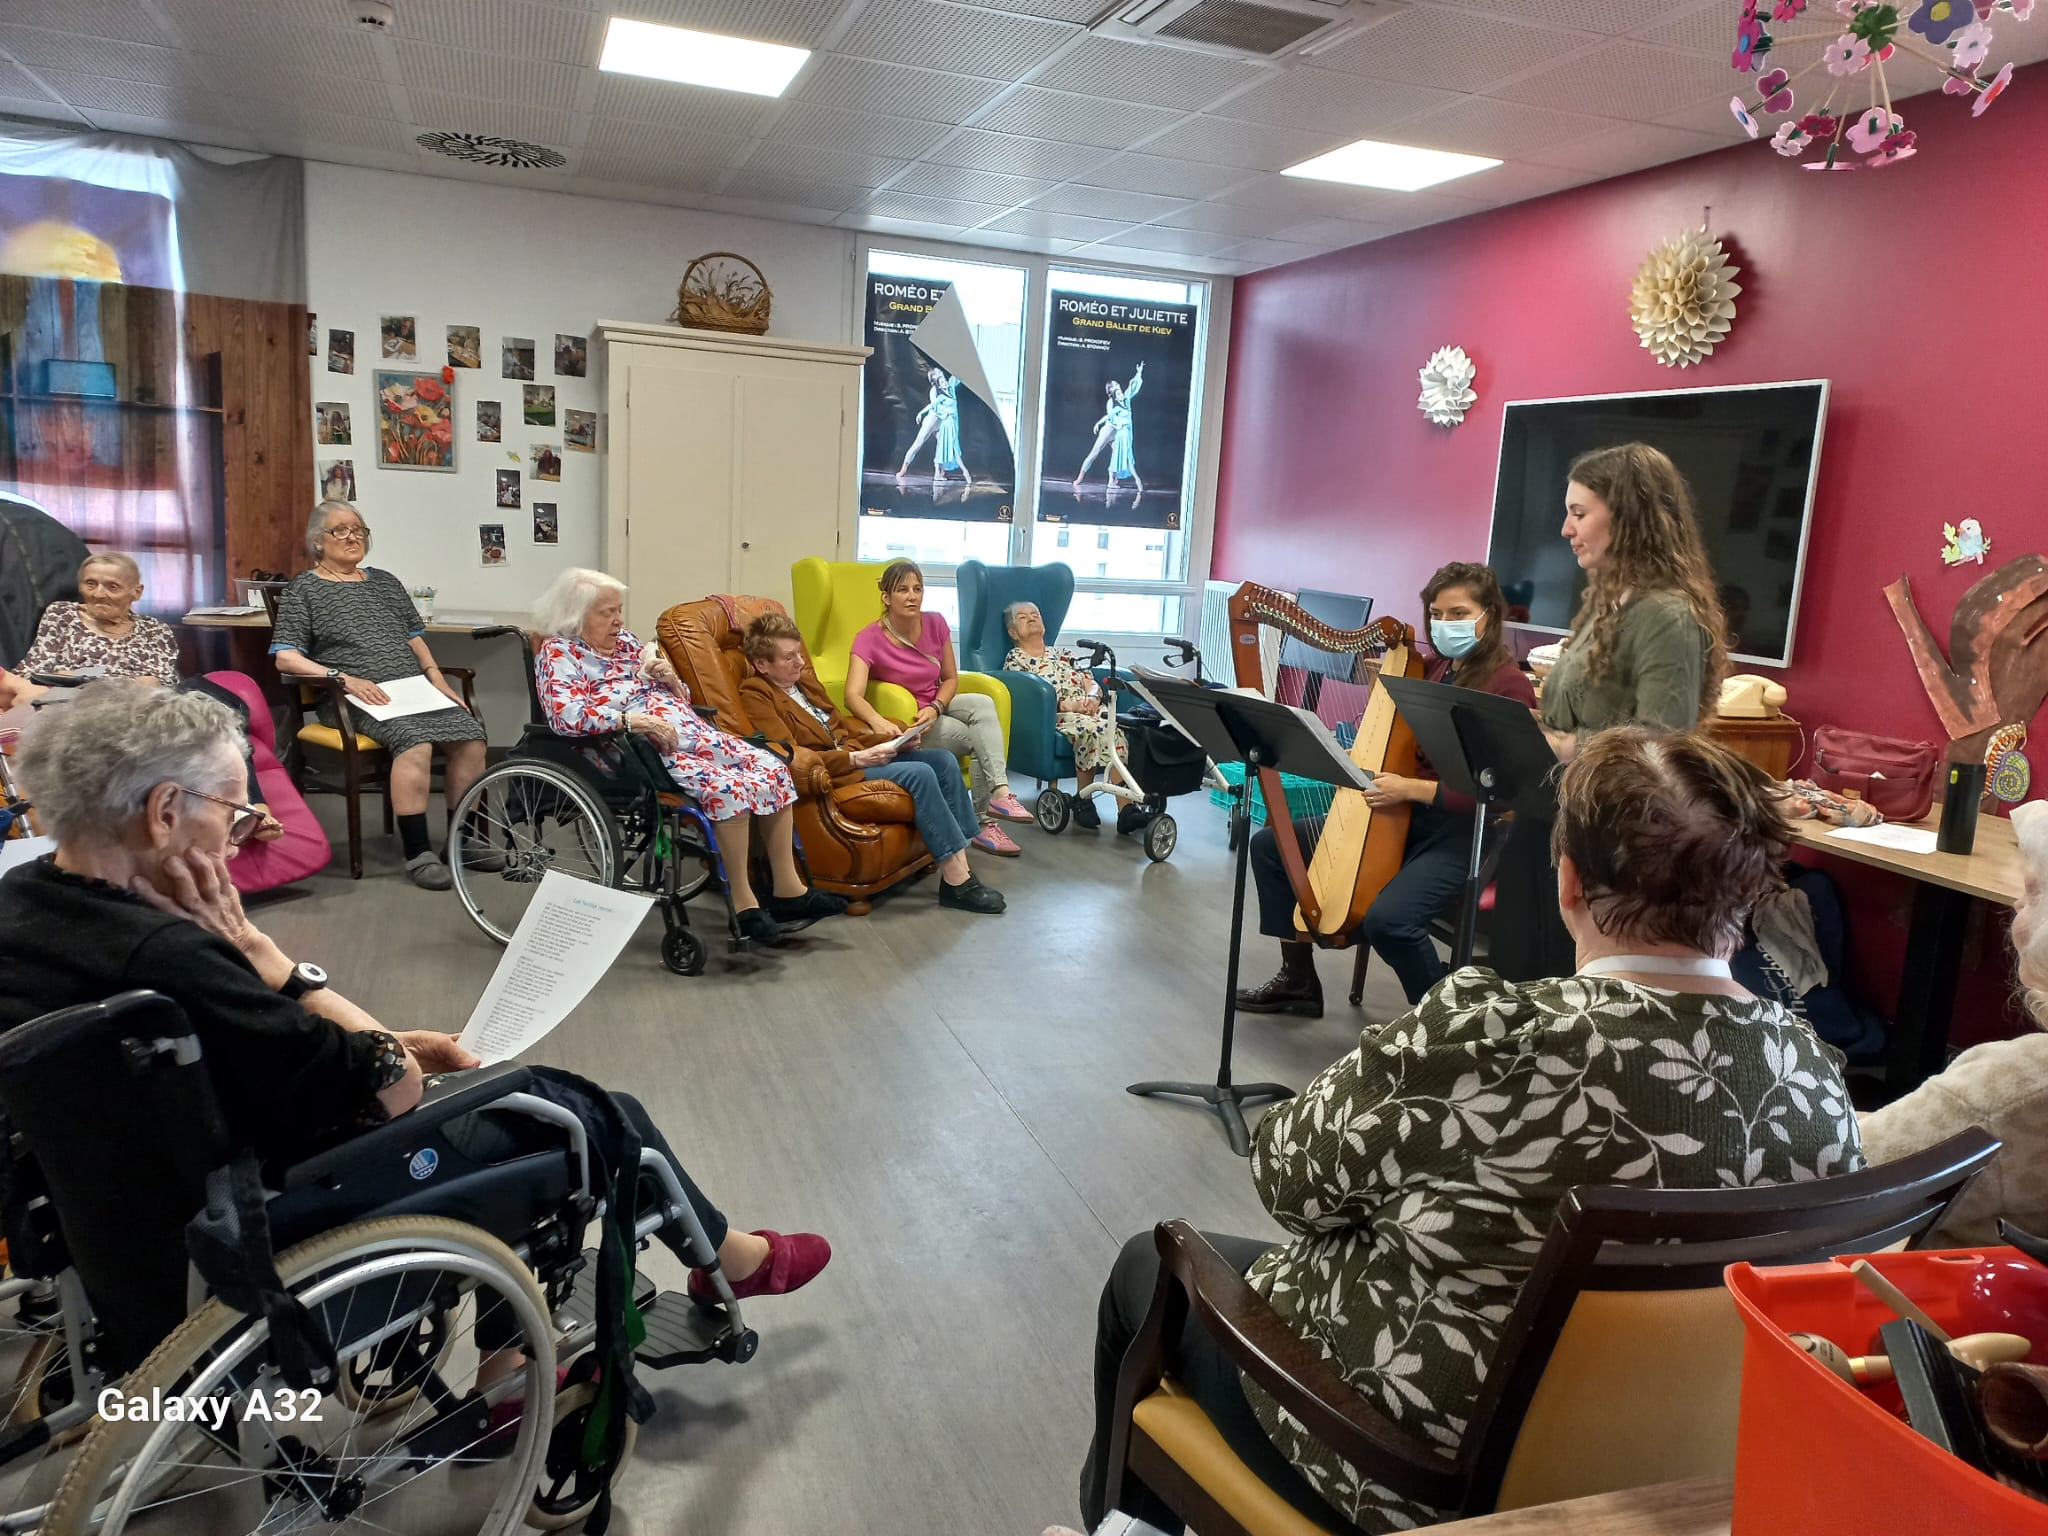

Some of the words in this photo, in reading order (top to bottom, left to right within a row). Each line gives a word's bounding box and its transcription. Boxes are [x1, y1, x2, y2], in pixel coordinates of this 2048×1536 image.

[874, 282, 928, 300] ROMÉO
[888, 301, 924, 313] GRAND
[1059, 299, 1109, 316] ROMÉO
[1111, 305, 1128, 317] ET
[1129, 307, 1188, 325] JULIETTE
[1072, 317, 1105, 328] GRAND
[1105, 320, 1138, 332] BALLET
